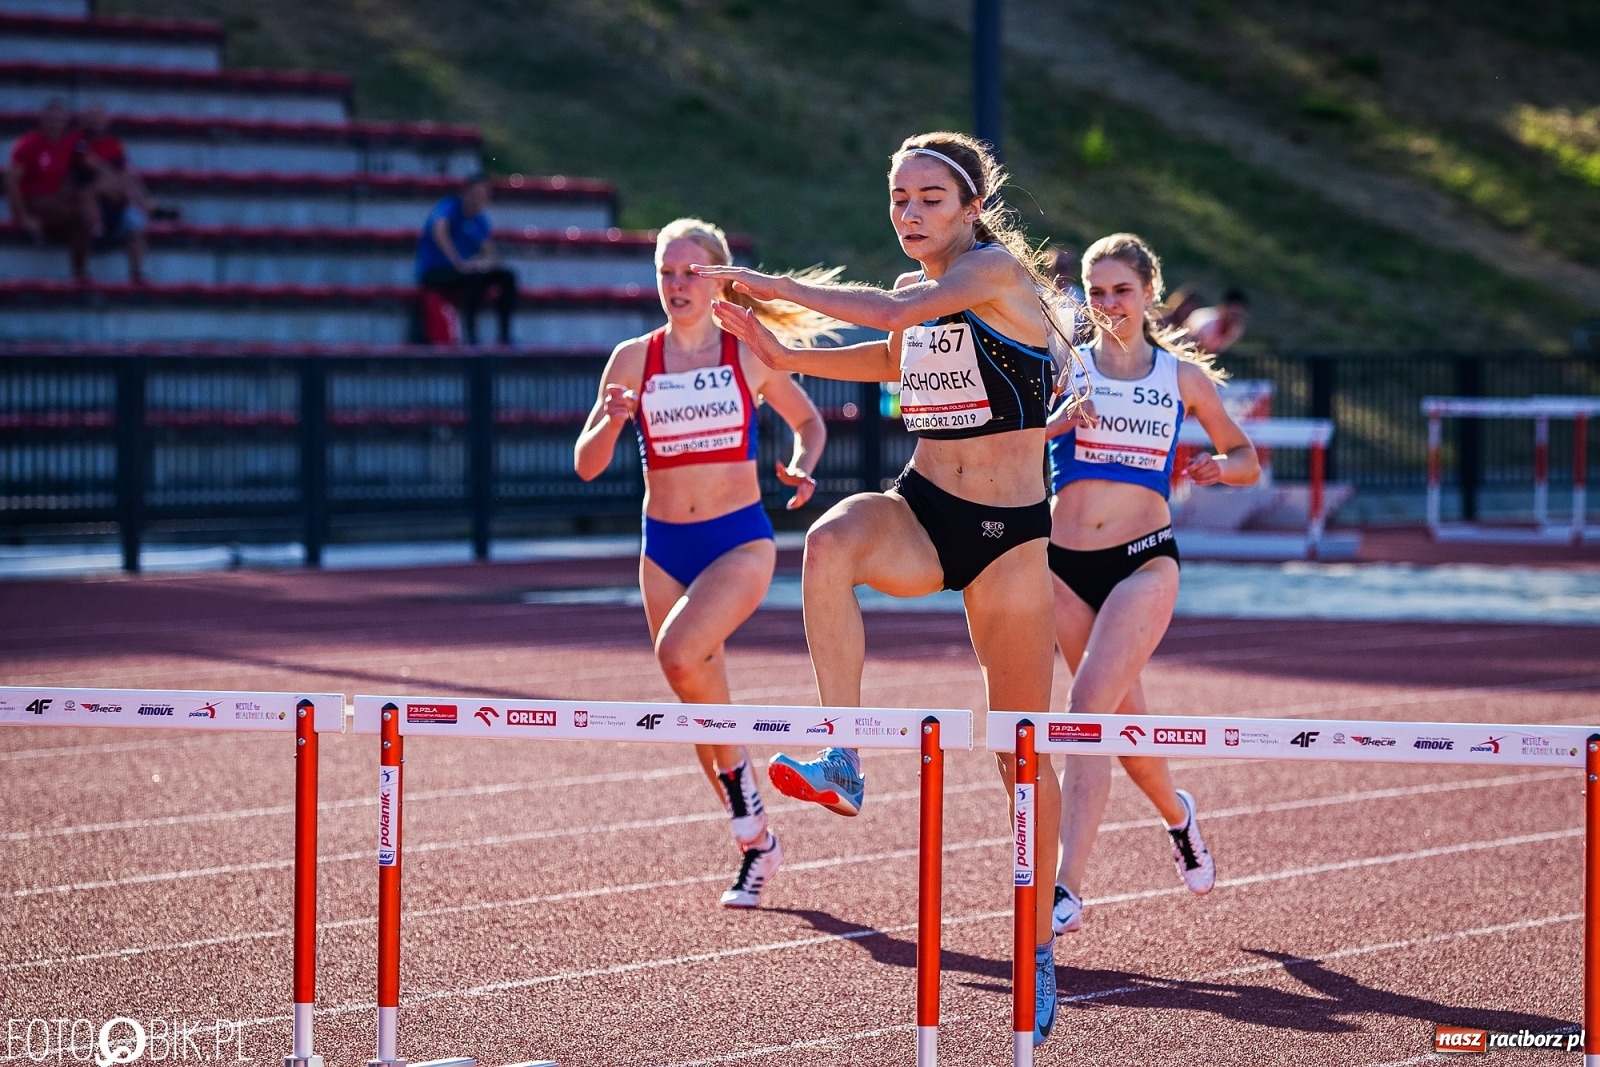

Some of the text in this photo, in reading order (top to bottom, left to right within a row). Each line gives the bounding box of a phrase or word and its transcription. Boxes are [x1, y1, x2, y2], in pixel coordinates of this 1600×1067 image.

[929, 328, 964, 354] 467
[694, 369, 732, 391] 619
[902, 369, 976, 391] ACHOREK
[1132, 386, 1173, 409] 536
[650, 400, 739, 426] JANKOWSKA
[906, 413, 976, 428] RACIBÓRZ 2019
[1097, 415, 1170, 438] NOWIEC
[1085, 450, 1136, 464] RACIBÓRZ
[1127, 534, 1158, 556] NIKE
[26, 699, 53, 714] 4F
[137, 706, 174, 716] 4MOVE
[509, 712, 554, 724] ORLEN
[636, 714, 664, 730] 4F
[752, 722, 791, 732] 4MOVE
[1156, 730, 1202, 743] ORLEN
[1290, 732, 1320, 748] 4F
[1414, 740, 1454, 750] 4MOVE
[380, 792, 392, 848] polanik
[1016, 810, 1030, 868] polanik
